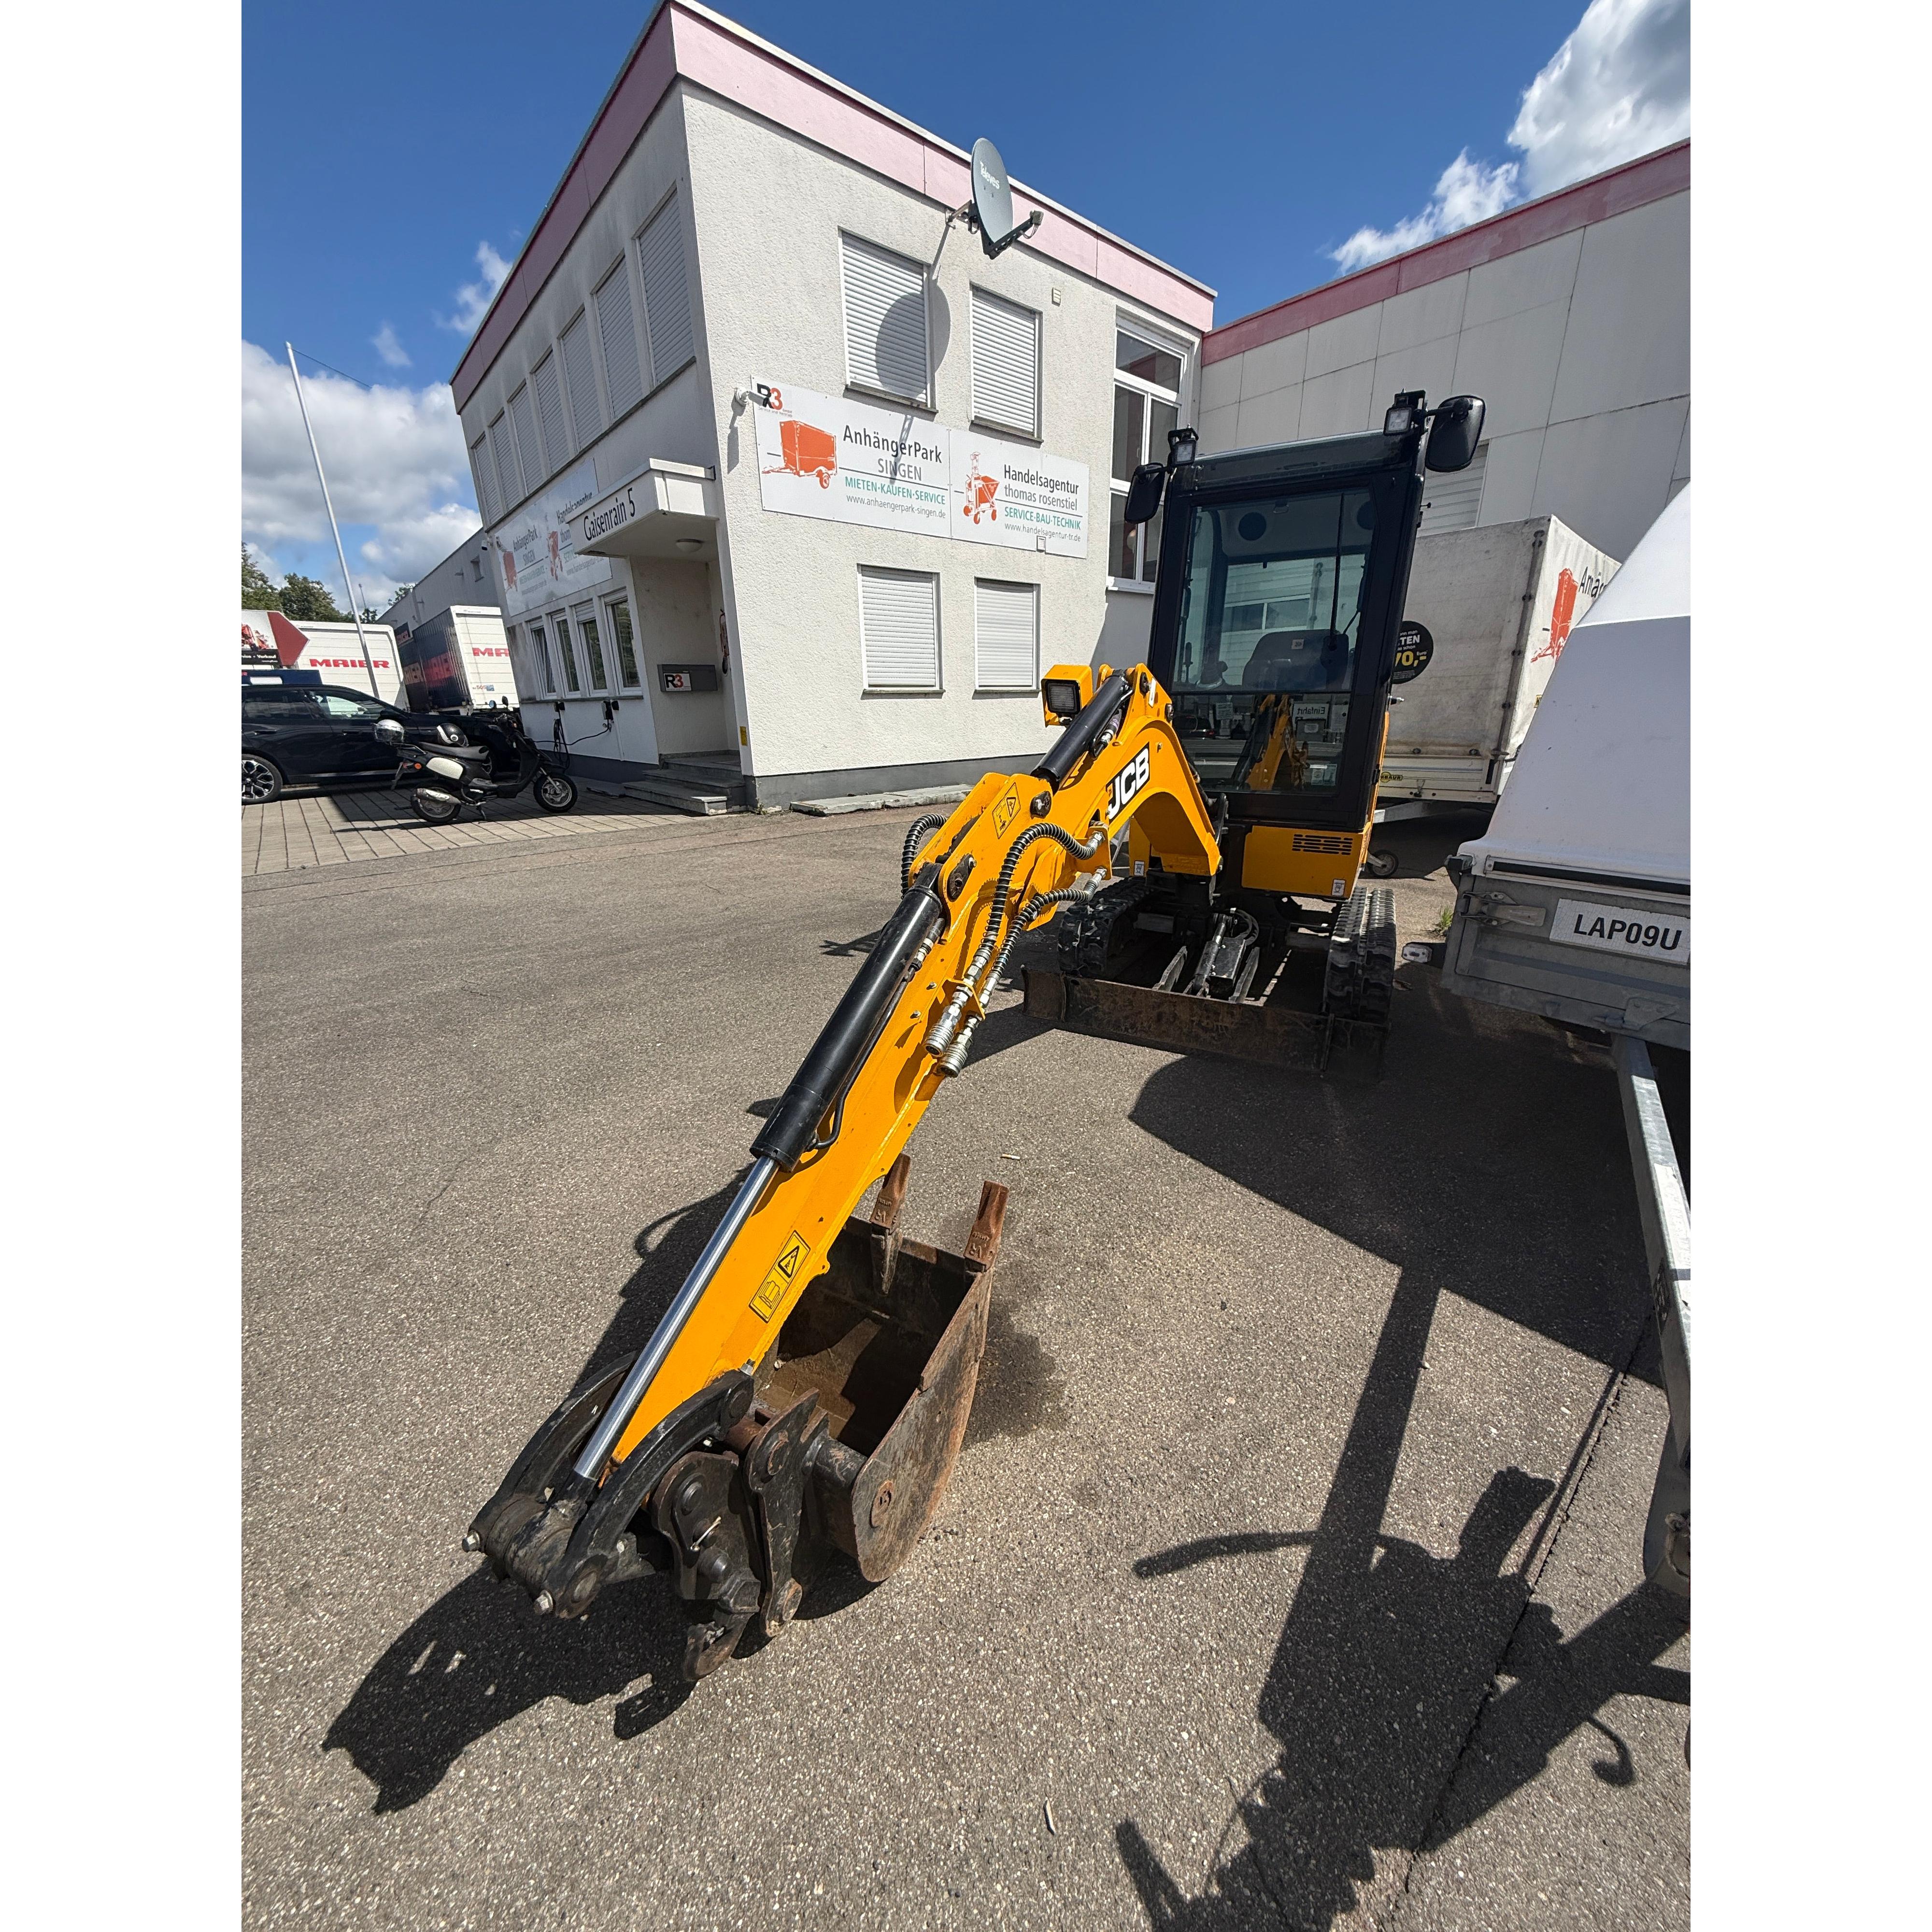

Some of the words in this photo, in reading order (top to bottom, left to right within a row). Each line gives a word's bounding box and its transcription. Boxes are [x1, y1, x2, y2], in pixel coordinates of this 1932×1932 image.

[757, 383, 783, 410] R3
[843, 425, 942, 463] AnhängerPark
[878, 458, 922, 481] SINGEN
[1004, 464, 1079, 495] Handelsagentur
[847, 495, 946, 518] www.anhaengerpark-singen.de
[1004, 483, 1037, 502] thomas
[1039, 494, 1077, 511] rosenstiel
[584, 497, 627, 541] Gaisenrain
[627, 487, 636, 517] 5
[1005, 523, 1081, 542] www.handelsagentur-tr.de
[1398, 635, 1420, 645] TEN
[309, 658, 390, 668] MAIER
[665, 674, 684, 688] R3
[1108, 748, 1149, 820] JCB
[1574, 914, 1682, 950] LAP09U
